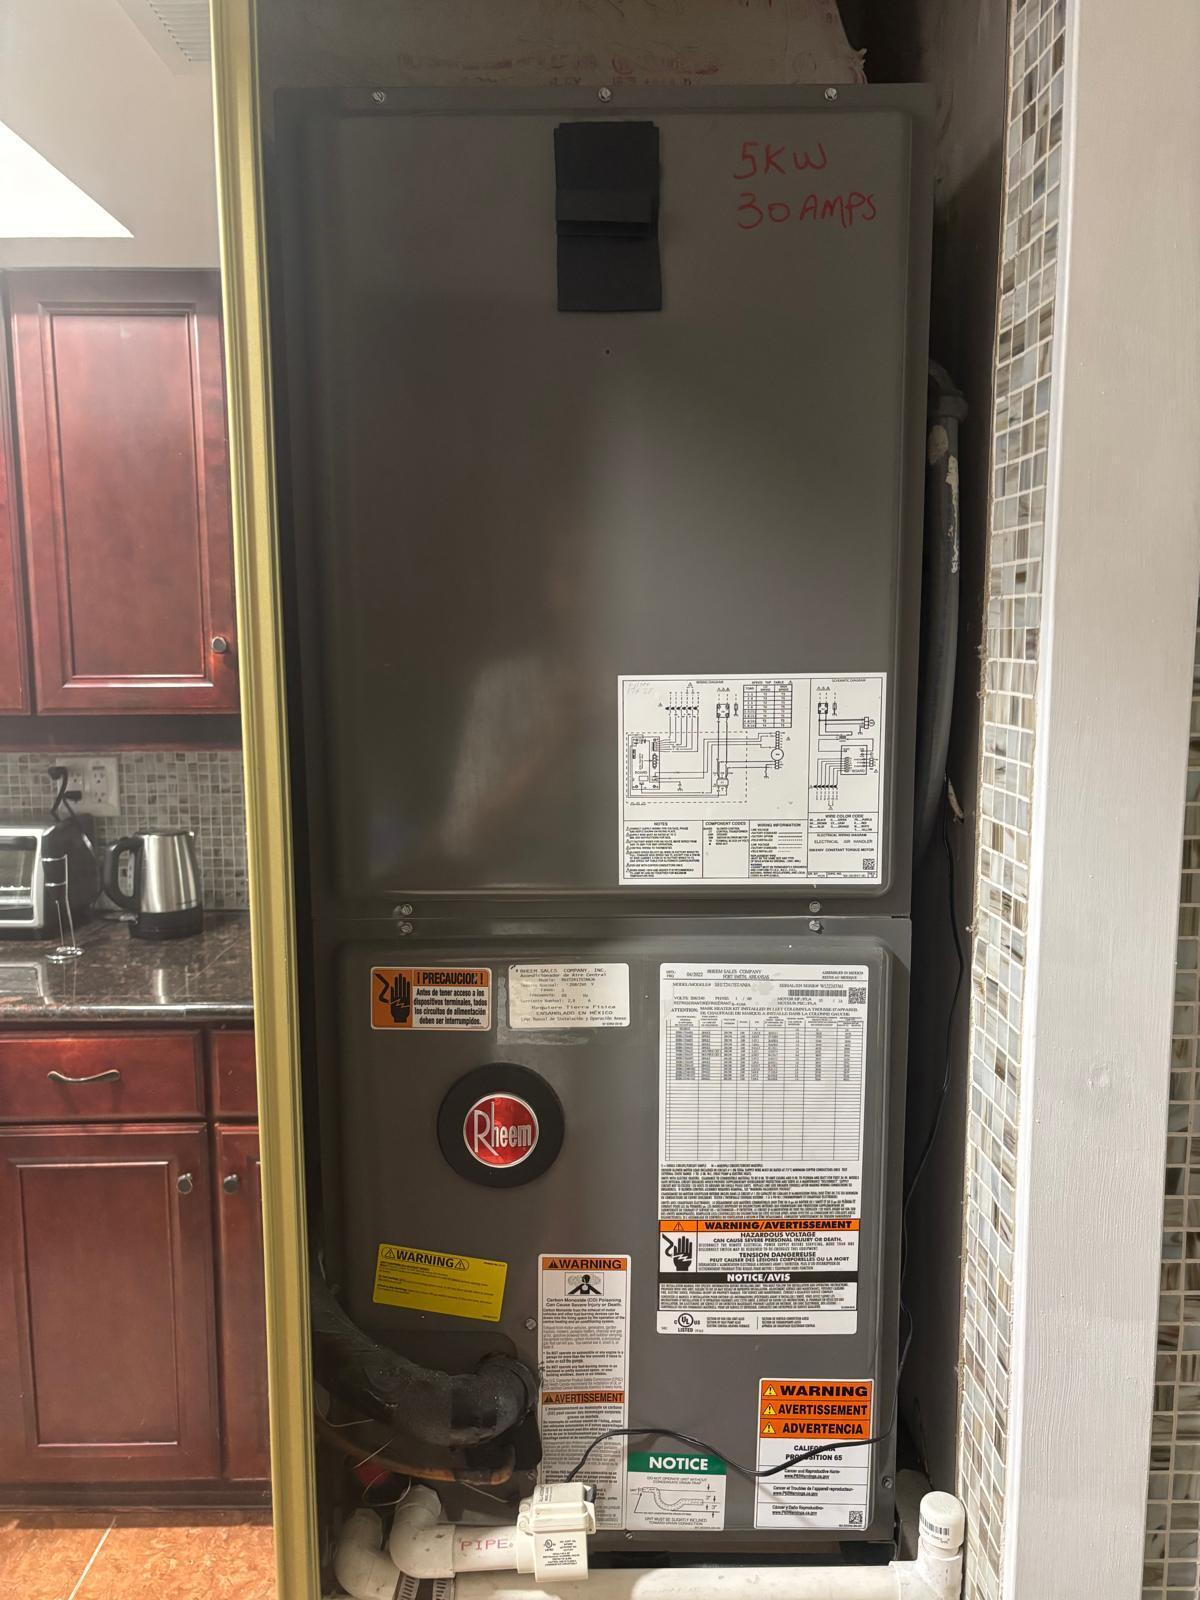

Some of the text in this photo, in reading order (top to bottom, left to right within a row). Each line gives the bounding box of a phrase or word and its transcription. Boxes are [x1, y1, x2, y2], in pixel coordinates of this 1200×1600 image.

[738, 191, 877, 230] 30 AMPS
[416, 988, 430, 996] Antes
[474, 998, 487, 1006] todos
[419, 1016, 434, 1024] deben
[474, 1102, 531, 1156] Rheem
[705, 1221, 852, 1230] WARNING/AVERTISSEMENT
[396, 1250, 454, 1268] WARNING
[559, 1260, 621, 1268] WARNING
[727, 1274, 791, 1282] NOTICE/AVIS
[780, 1386, 867, 1397] WARNING
[555, 1393, 624, 1403] AVERTISSEMENT
[778, 1404, 867, 1416] AVERTISSEMENT
[782, 1423, 863, 1434] ADVERTENCIA
[649, 1456, 708, 1470] NOTICE
